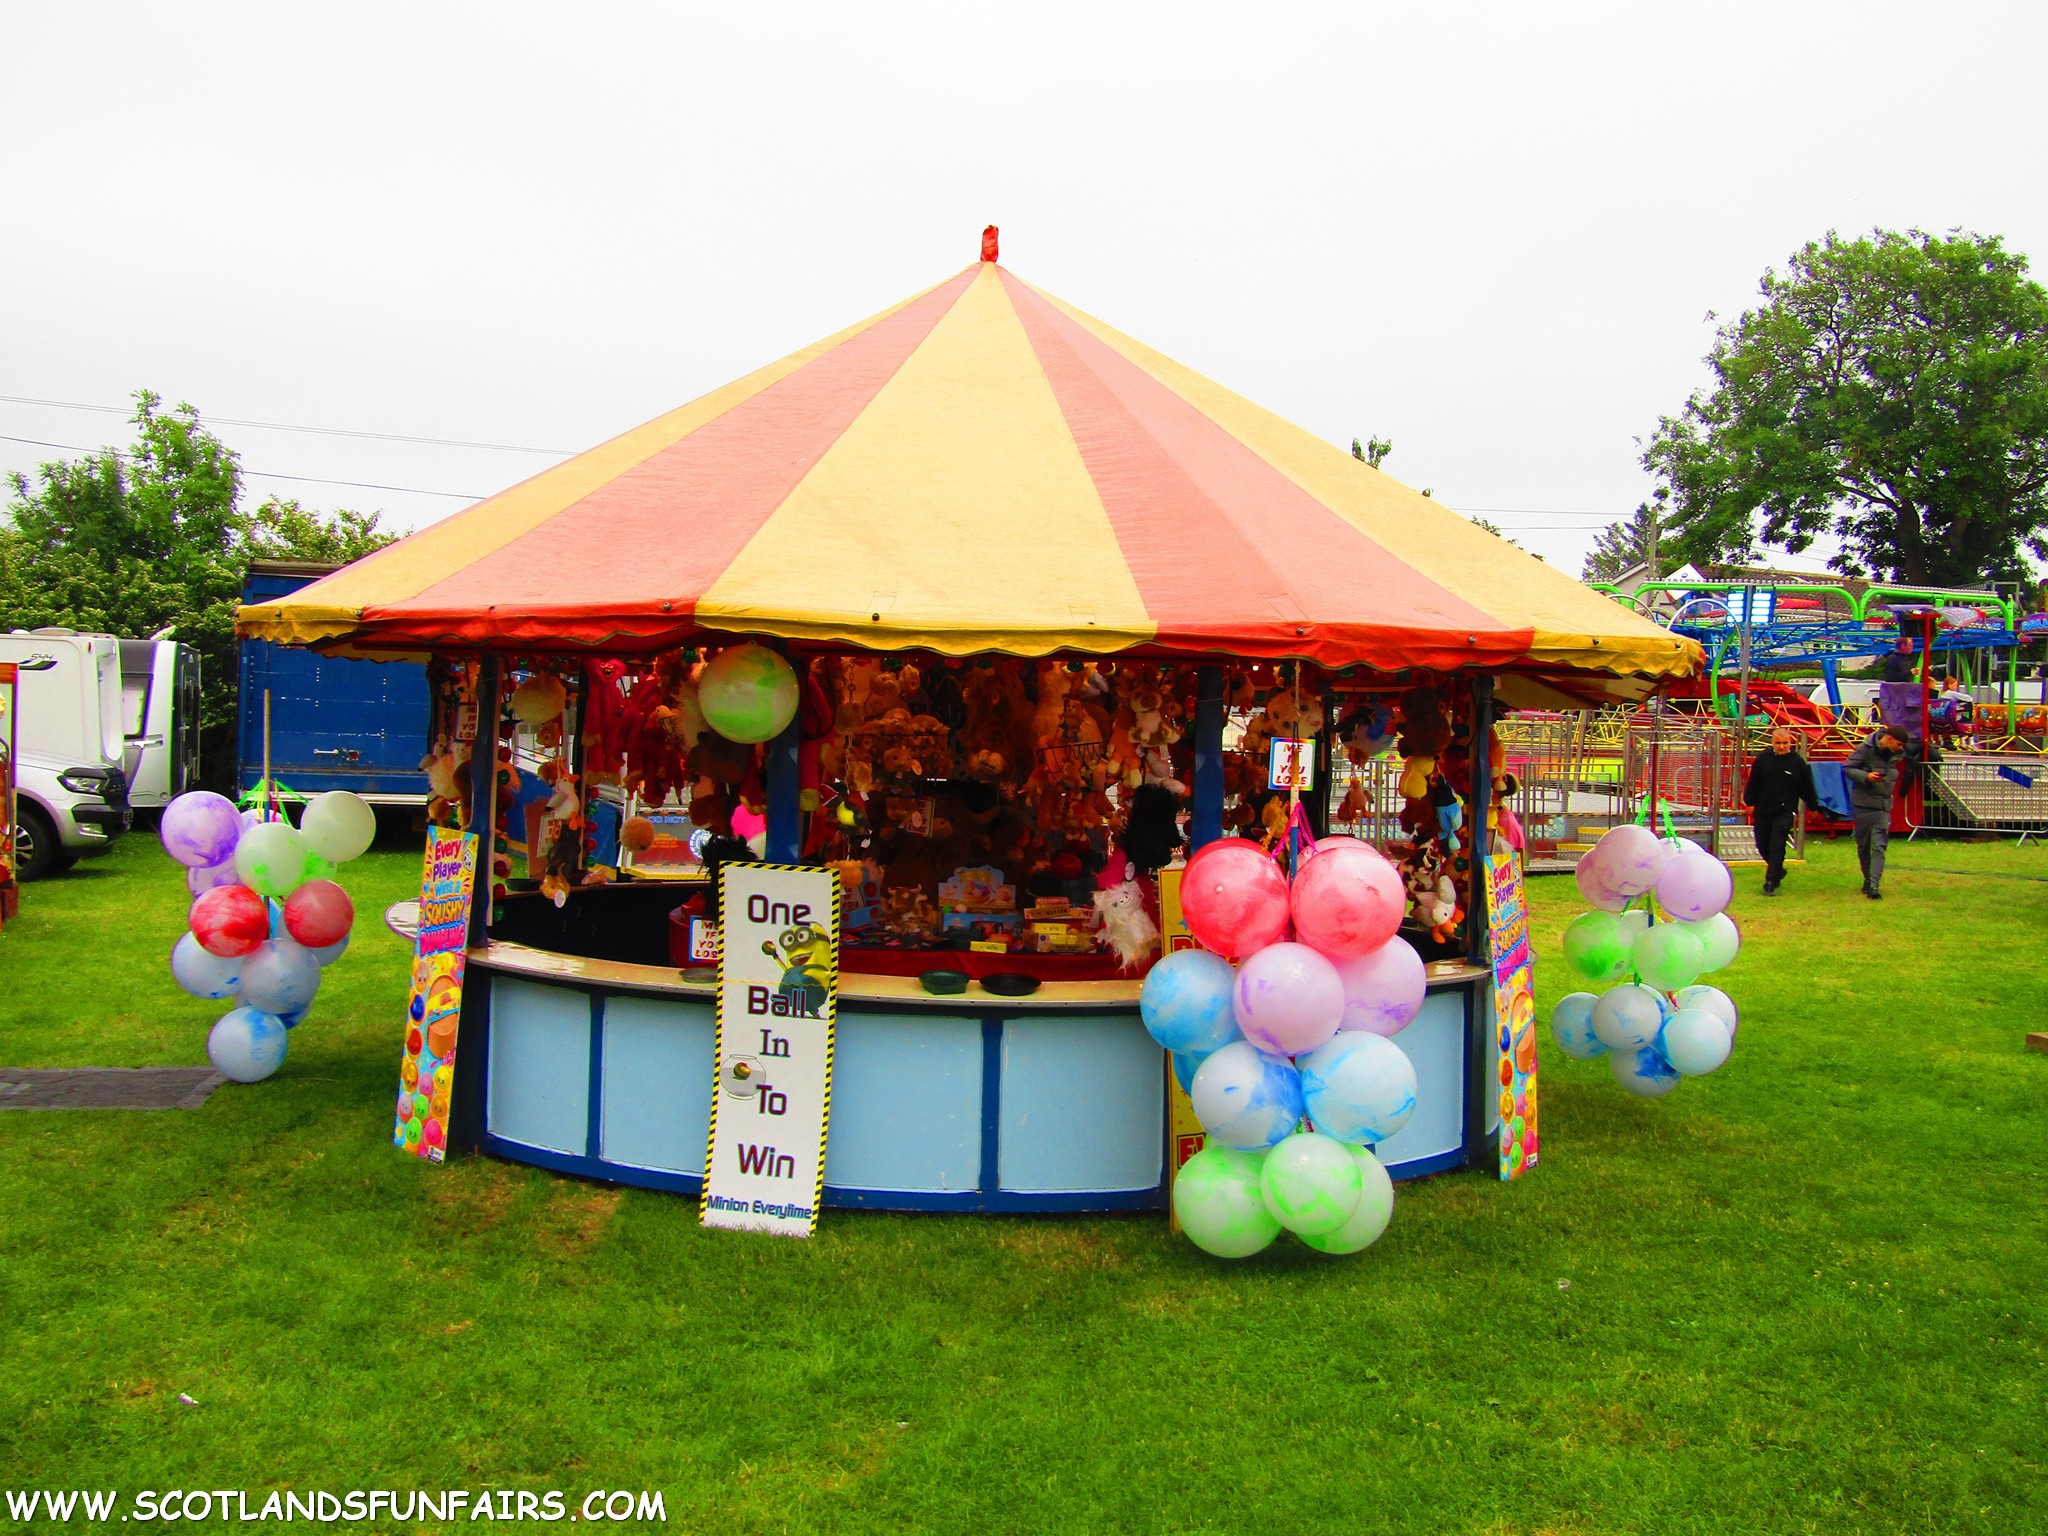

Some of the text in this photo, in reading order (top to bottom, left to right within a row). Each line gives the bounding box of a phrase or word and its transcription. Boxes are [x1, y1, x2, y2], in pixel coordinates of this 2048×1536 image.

[1275, 775, 1308, 785] LOE
[435, 840, 462, 861] Every
[1494, 862, 1512, 888] Every
[748, 894, 811, 927] One
[695, 949, 719, 959] LOS
[747, 985, 807, 1018] Ball
[759, 1028, 791, 1058] In
[756, 1084, 788, 1116] To
[738, 1143, 795, 1179] Win
[706, 1195, 813, 1220] Minion Everytime
